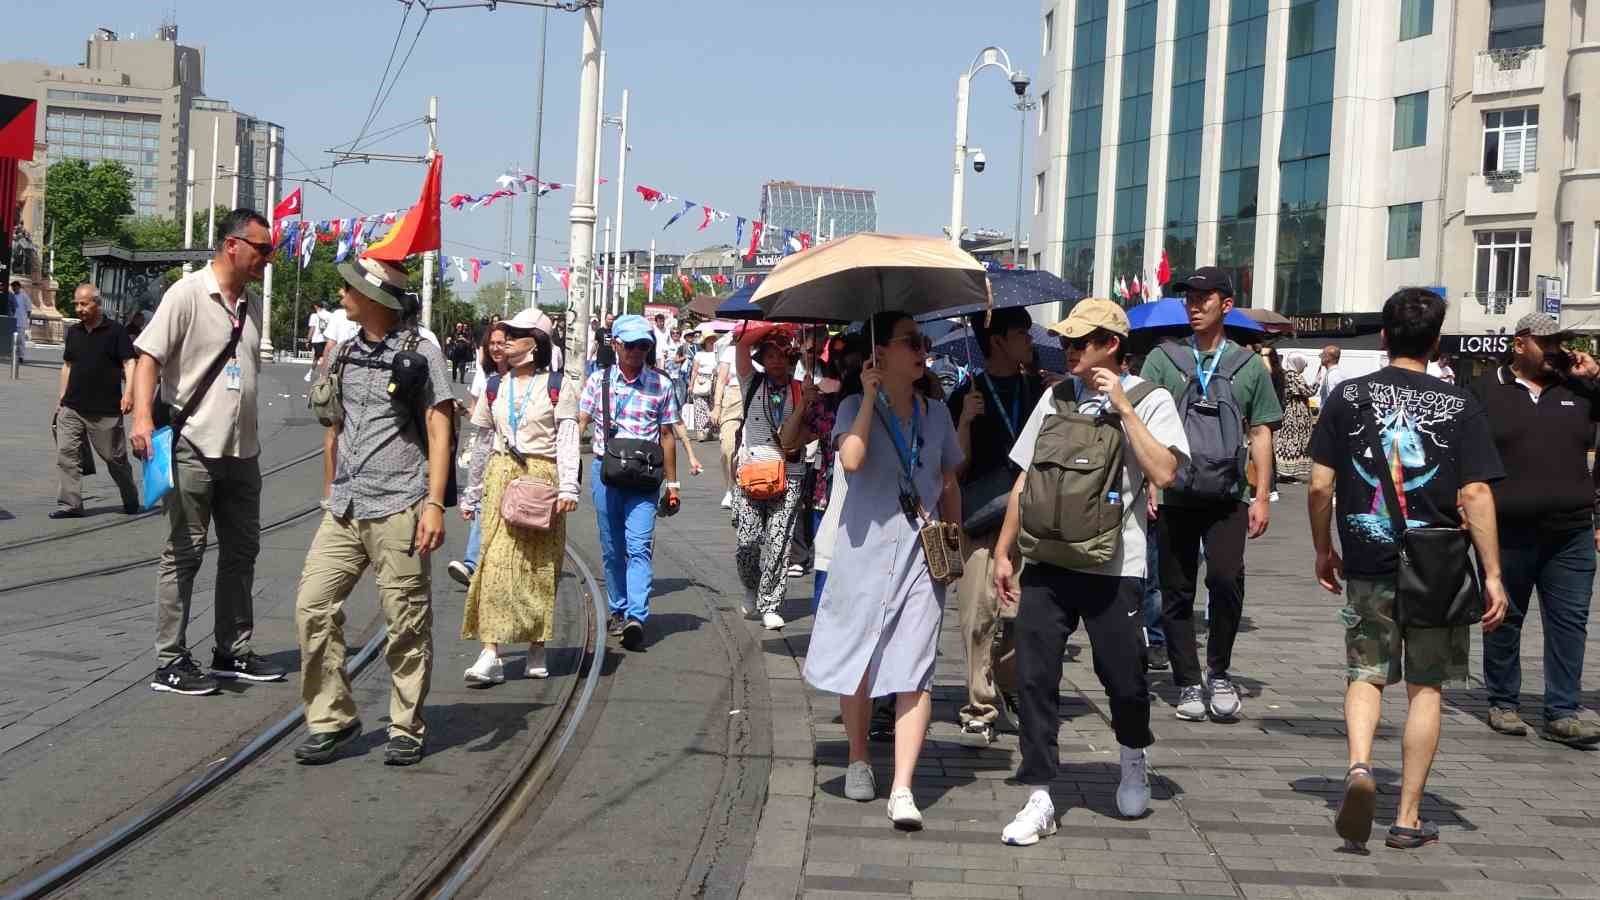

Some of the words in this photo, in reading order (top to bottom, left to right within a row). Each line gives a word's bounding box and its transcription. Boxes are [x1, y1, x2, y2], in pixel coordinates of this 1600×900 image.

[1460, 336, 1507, 353] LORIS
[1342, 381, 1395, 403] PNK
[1396, 388, 1465, 414] FLOYD
